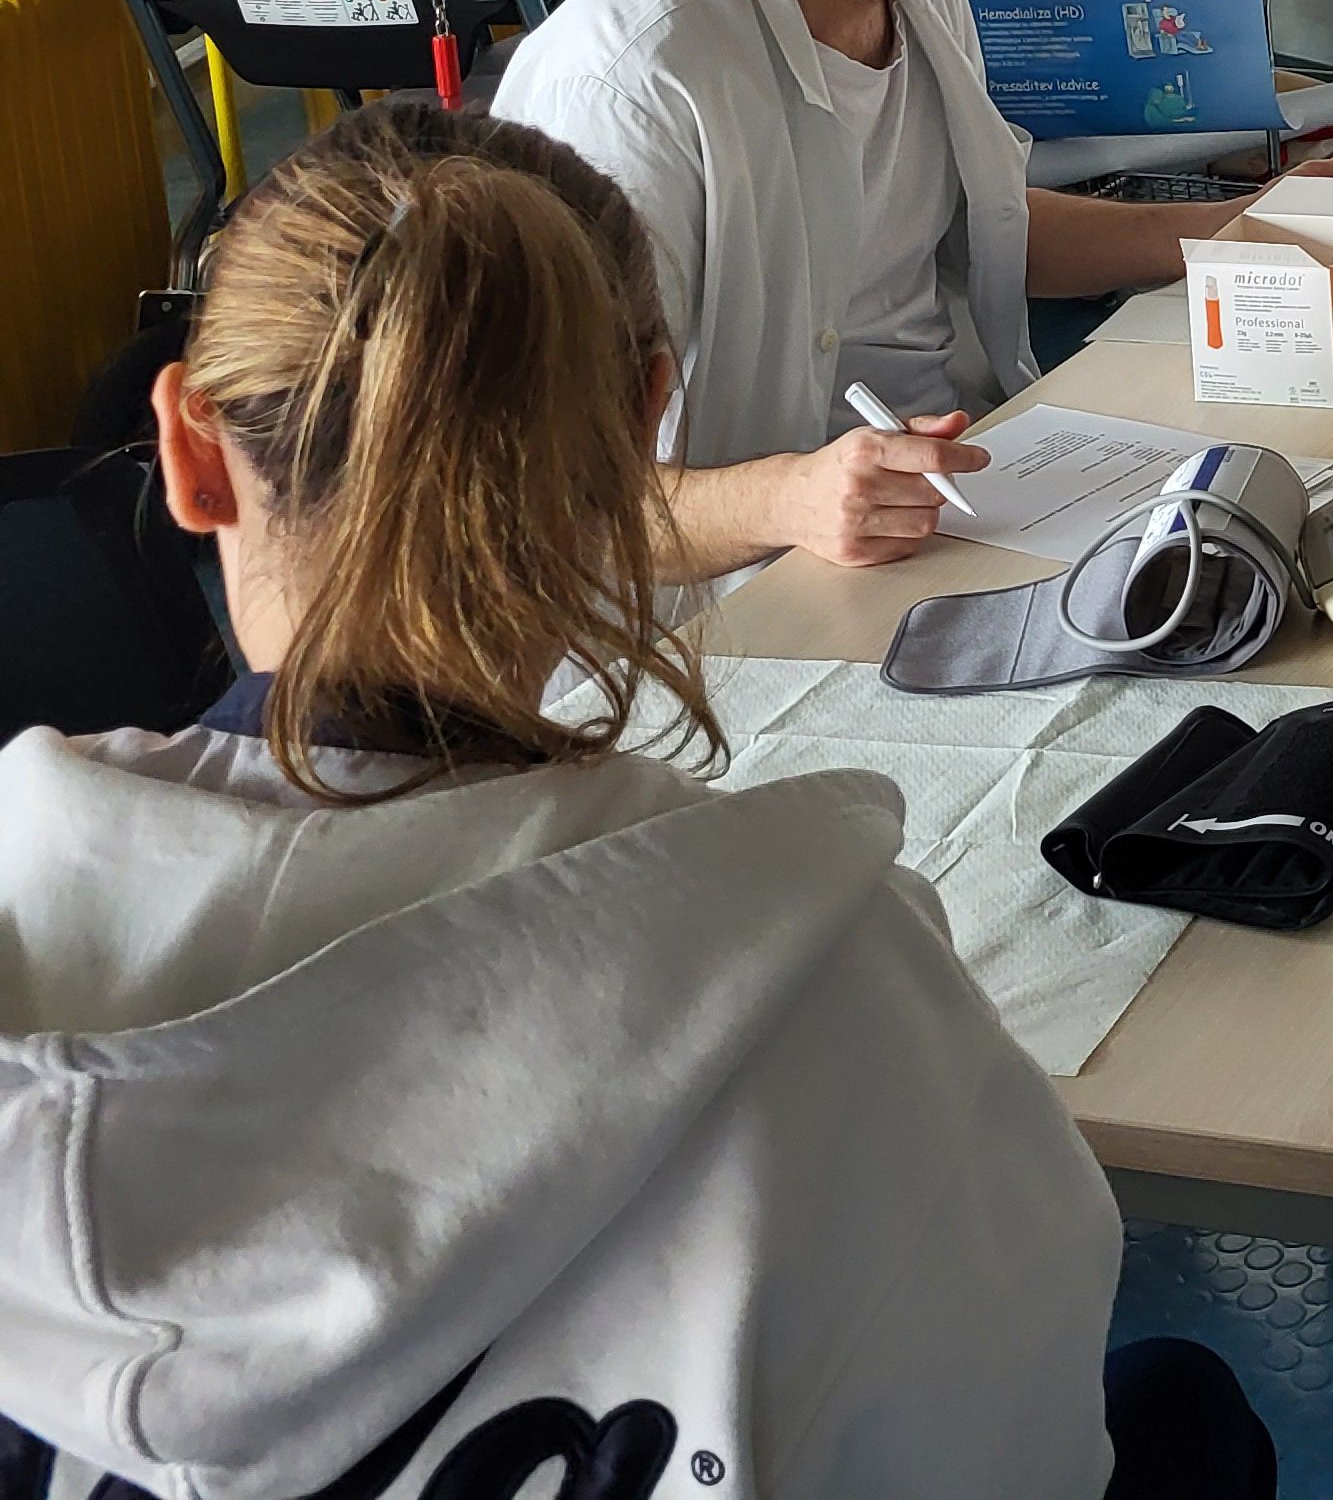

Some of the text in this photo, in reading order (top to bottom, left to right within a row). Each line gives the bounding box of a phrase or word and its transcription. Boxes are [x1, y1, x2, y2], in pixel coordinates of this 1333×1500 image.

[979, 5, 1084, 20] Hemodializa (HD)
[990, 79, 1100, 91] Presaditev ledvice
[1235, 272, 1302, 286] microdot
[1236, 317, 1304, 329] Professional
